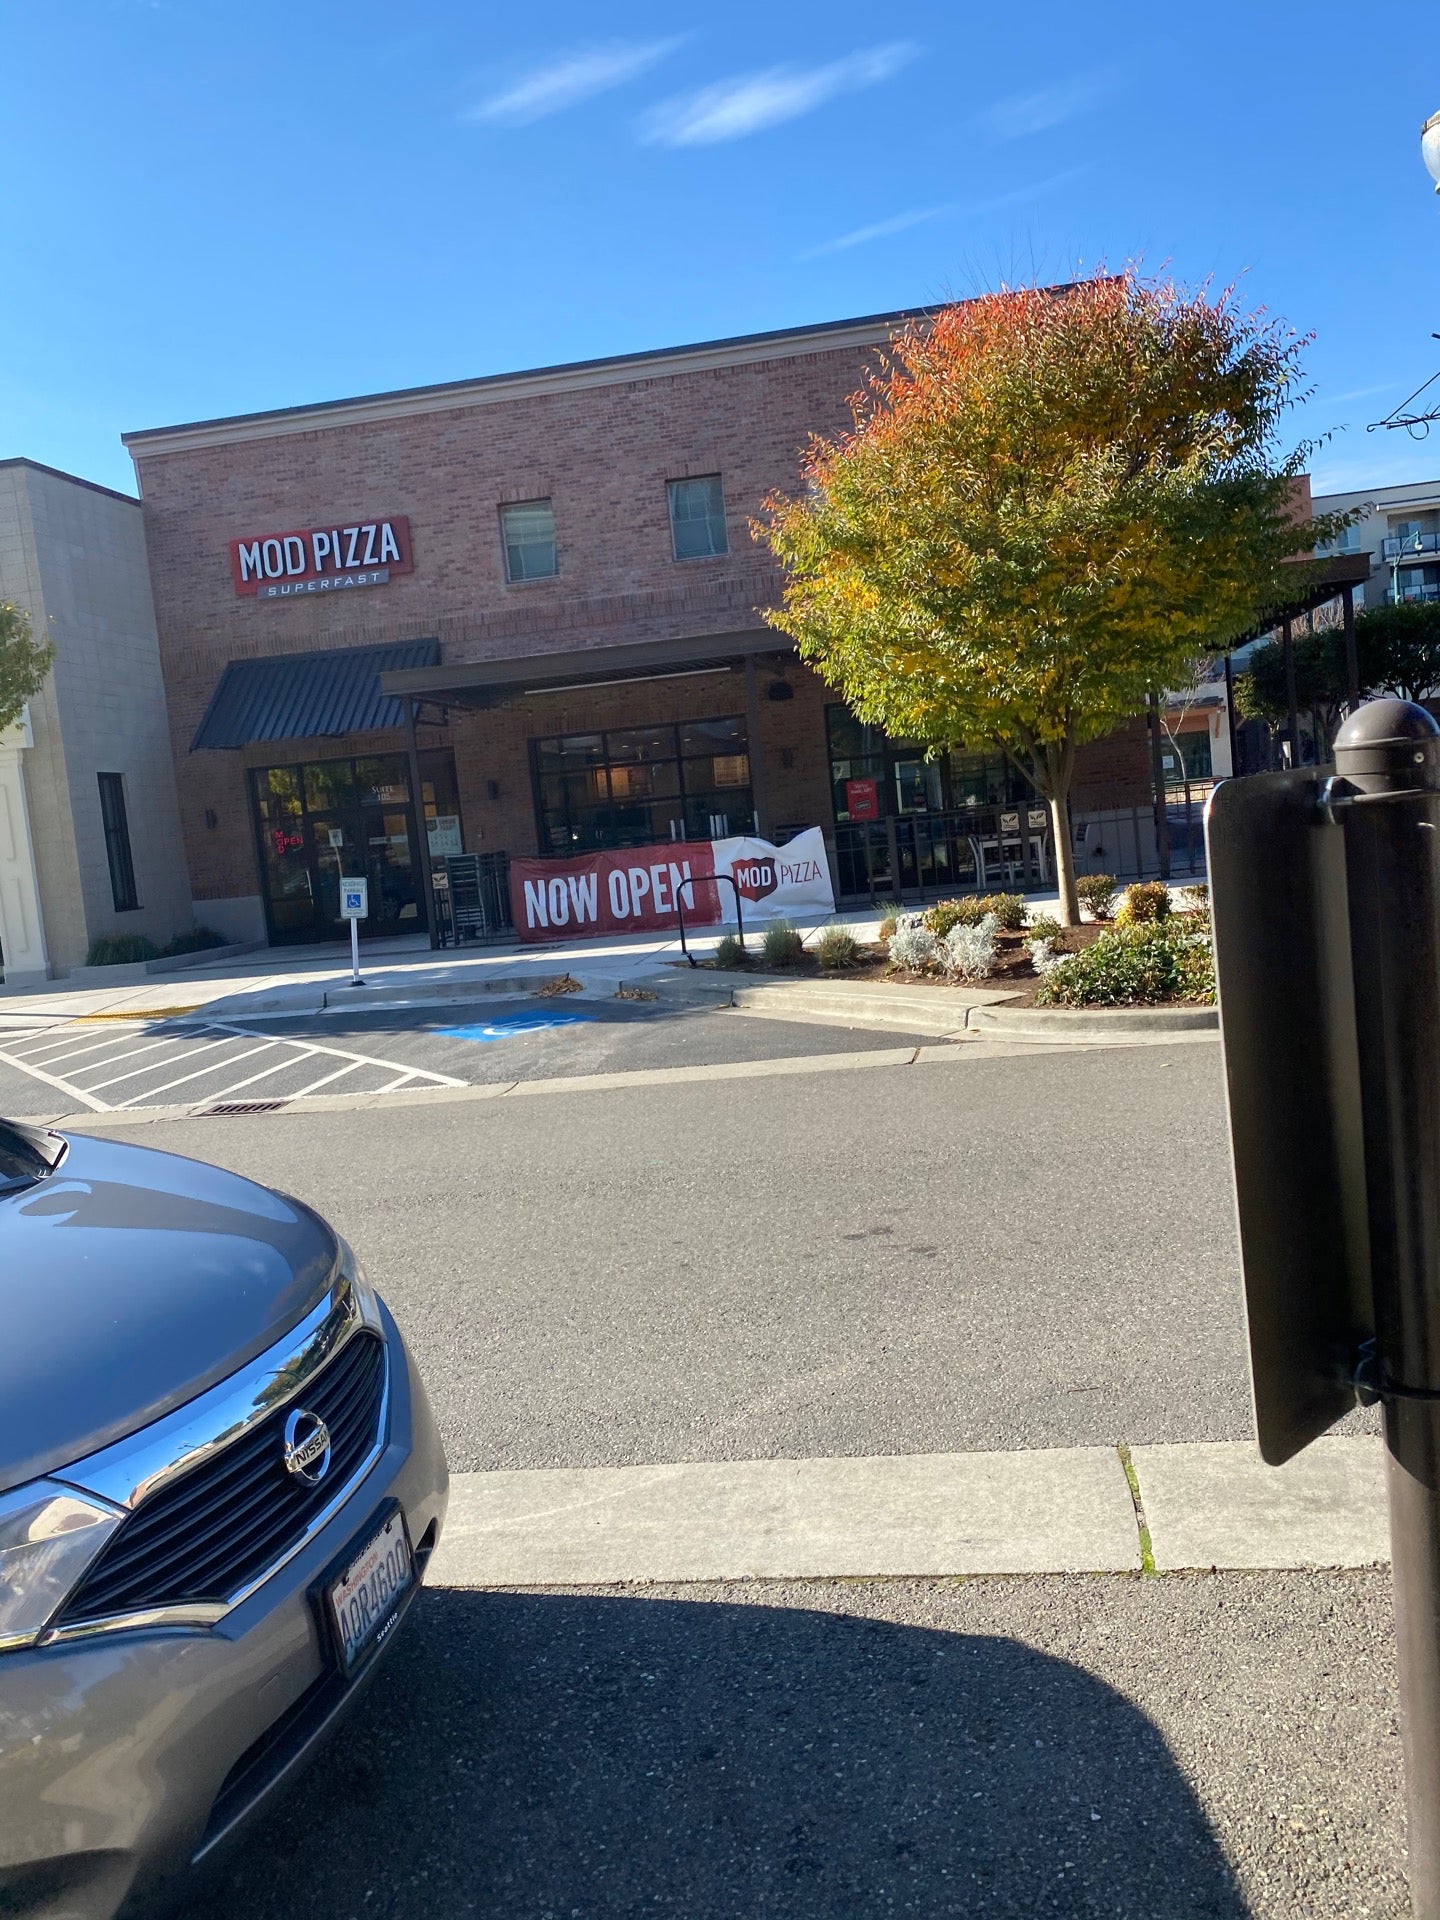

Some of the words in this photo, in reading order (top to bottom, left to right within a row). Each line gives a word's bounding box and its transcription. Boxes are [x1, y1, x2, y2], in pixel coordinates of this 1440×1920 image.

[238, 536, 306, 582] MOD
[312, 522, 400, 572] PIZZA
[268, 572, 380, 597] SUPERFAST
[523, 872, 598, 929] NOW
[608, 860, 696, 919] OPEN
[736, 866, 772, 890] MOD
[781, 860, 823, 884] PIZZA
[335, 1552, 379, 1608] WASHINGTON
[376, 1612, 399, 1643] Seattle
